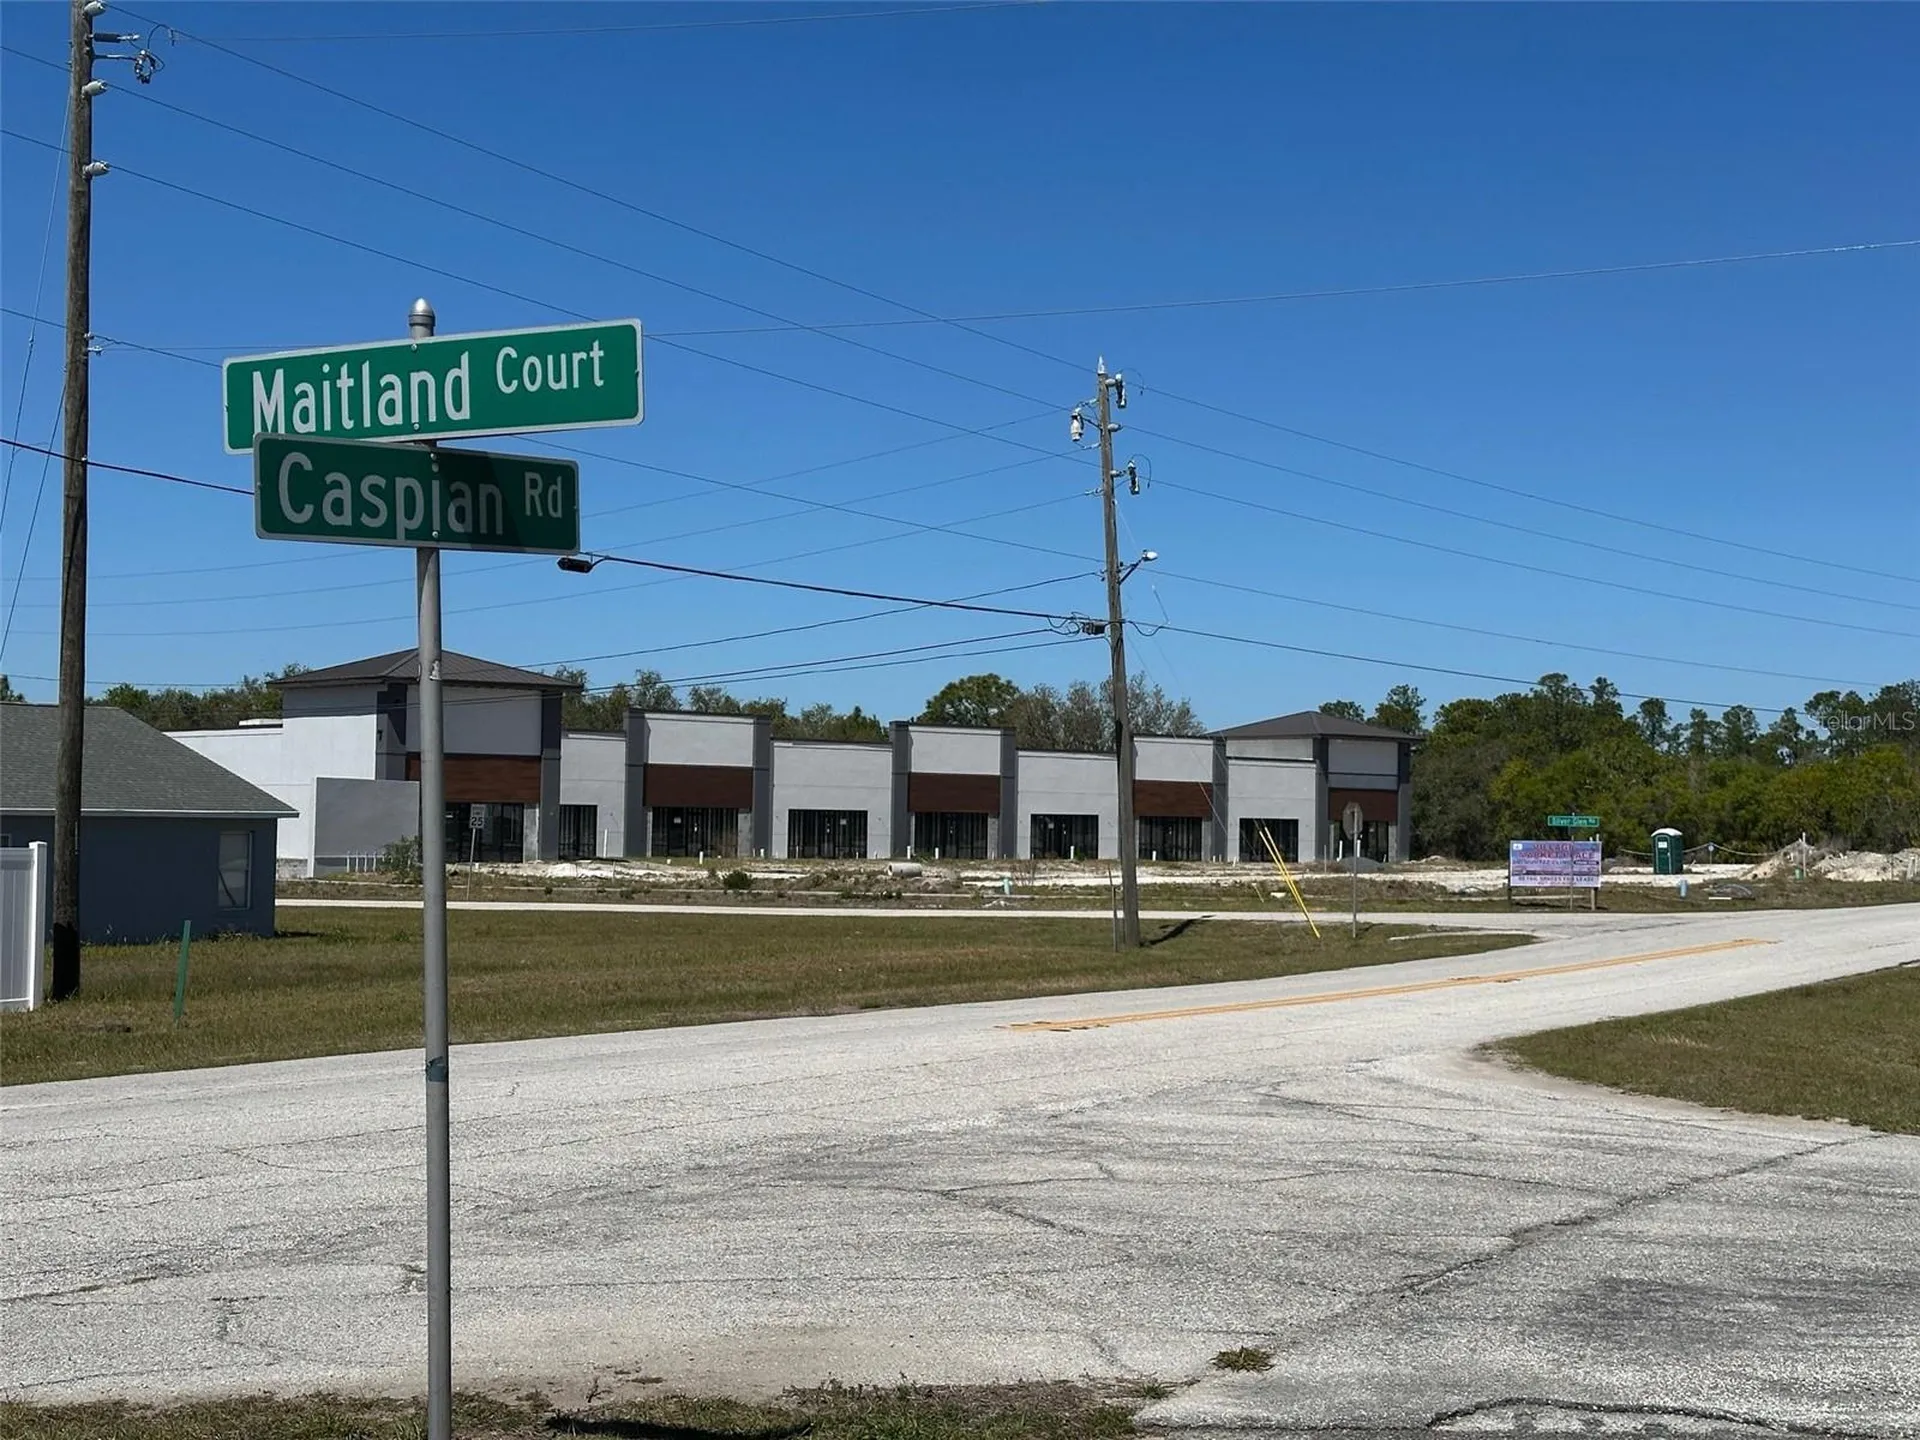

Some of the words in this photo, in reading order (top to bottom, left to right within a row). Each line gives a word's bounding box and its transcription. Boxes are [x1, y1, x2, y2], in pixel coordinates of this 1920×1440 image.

[252, 351, 471, 434] Maitland
[495, 339, 605, 394] Court
[278, 452, 504, 541] Caspian
[523, 471, 563, 519] Rd
[471, 816, 483, 826] 25
